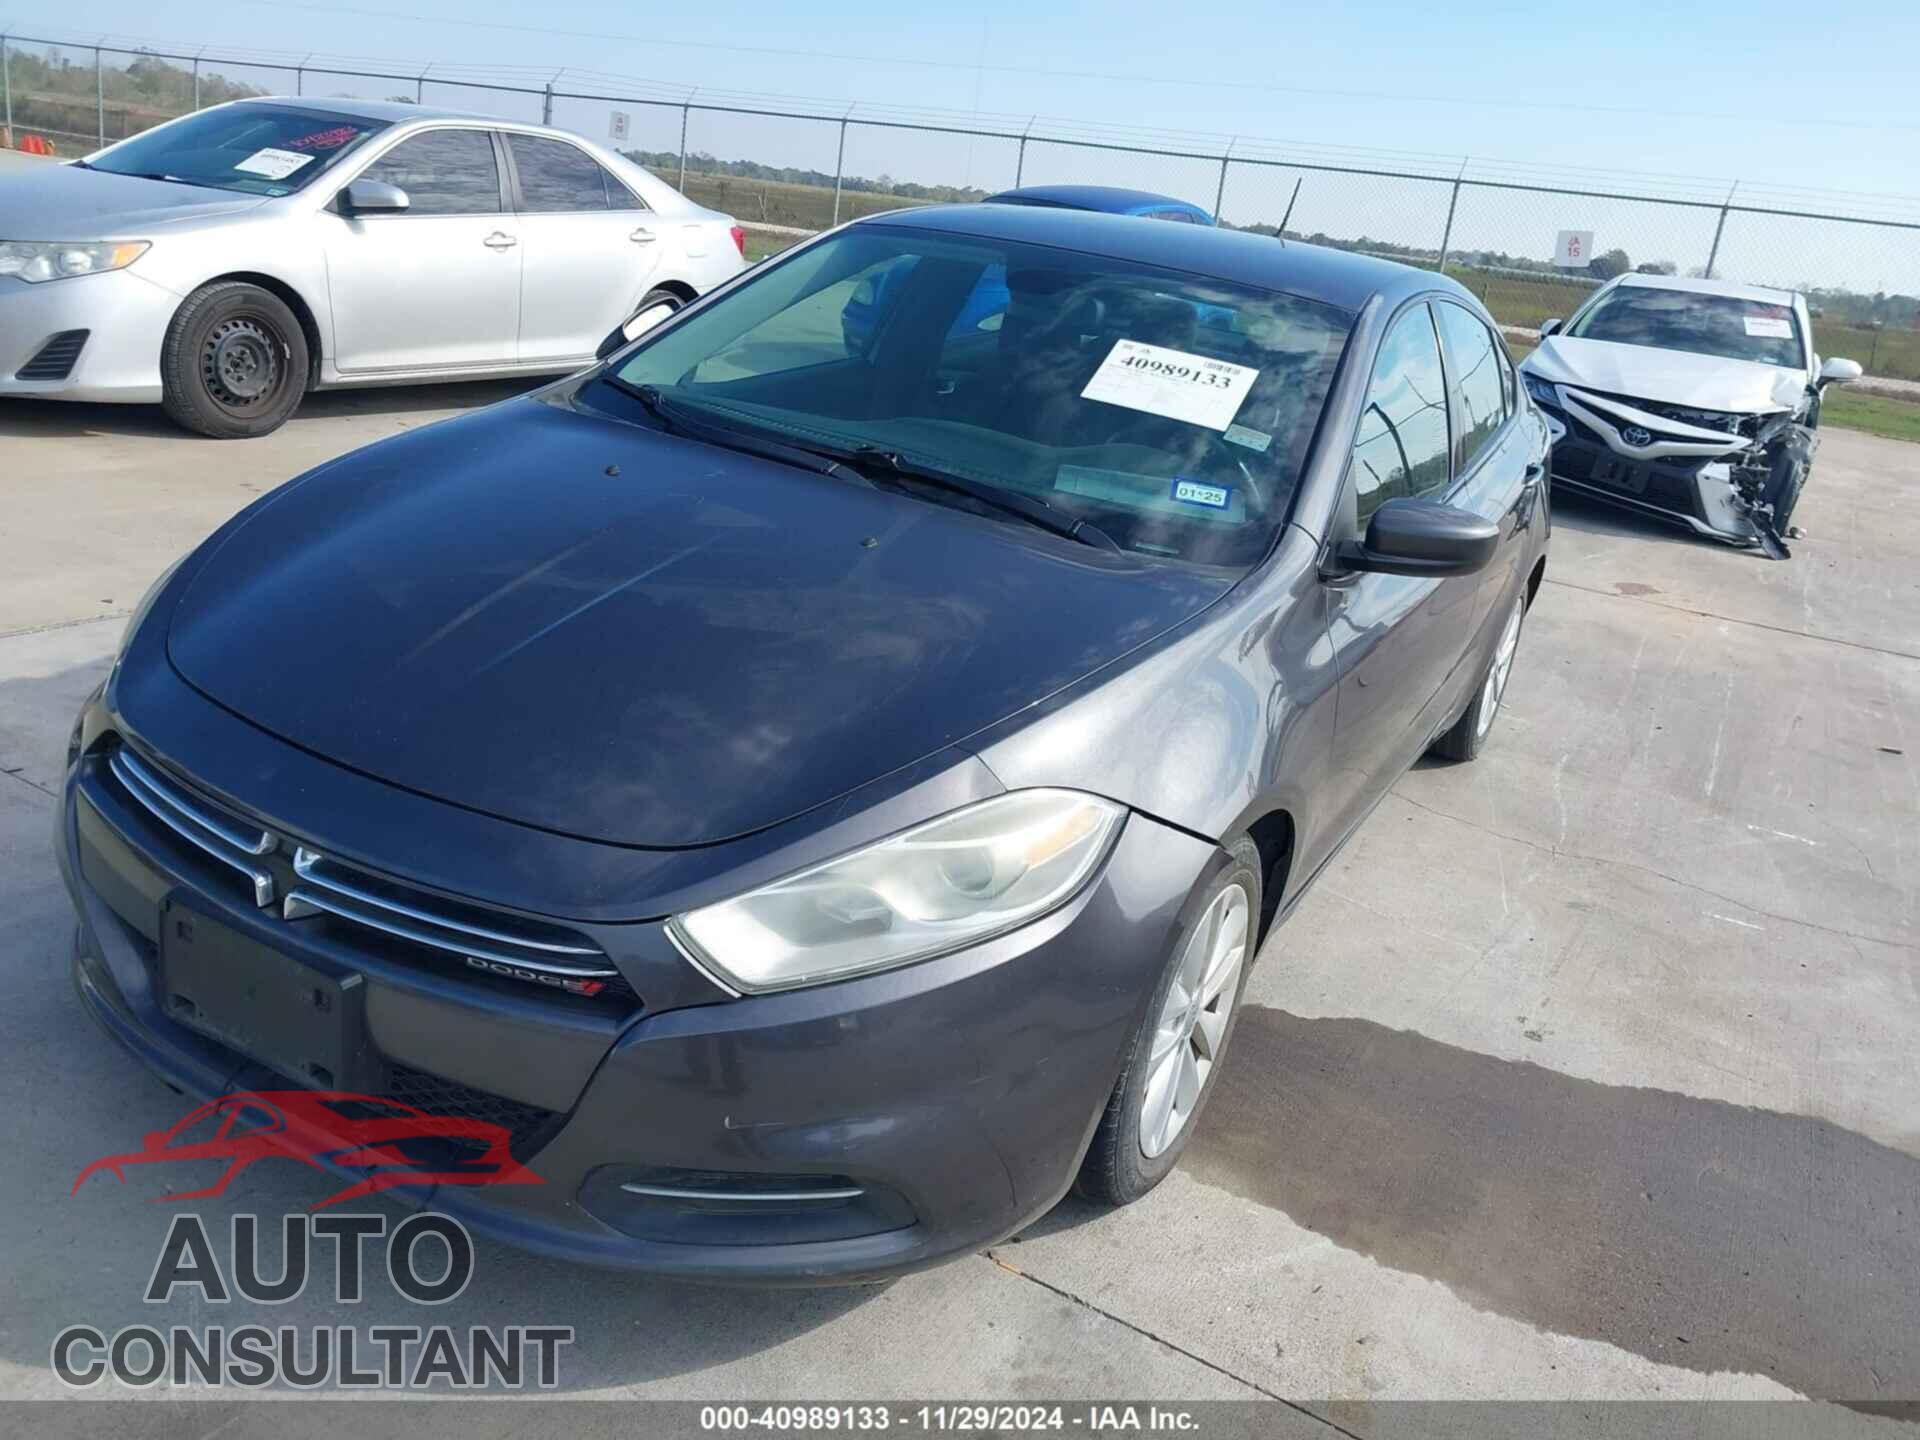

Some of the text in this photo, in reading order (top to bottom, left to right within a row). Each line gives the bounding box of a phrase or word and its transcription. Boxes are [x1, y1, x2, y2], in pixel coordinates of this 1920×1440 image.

[1568, 247, 1581, 257] 15
[1120, 355, 1232, 389] 40989133
[466, 956, 588, 996] DODGE
